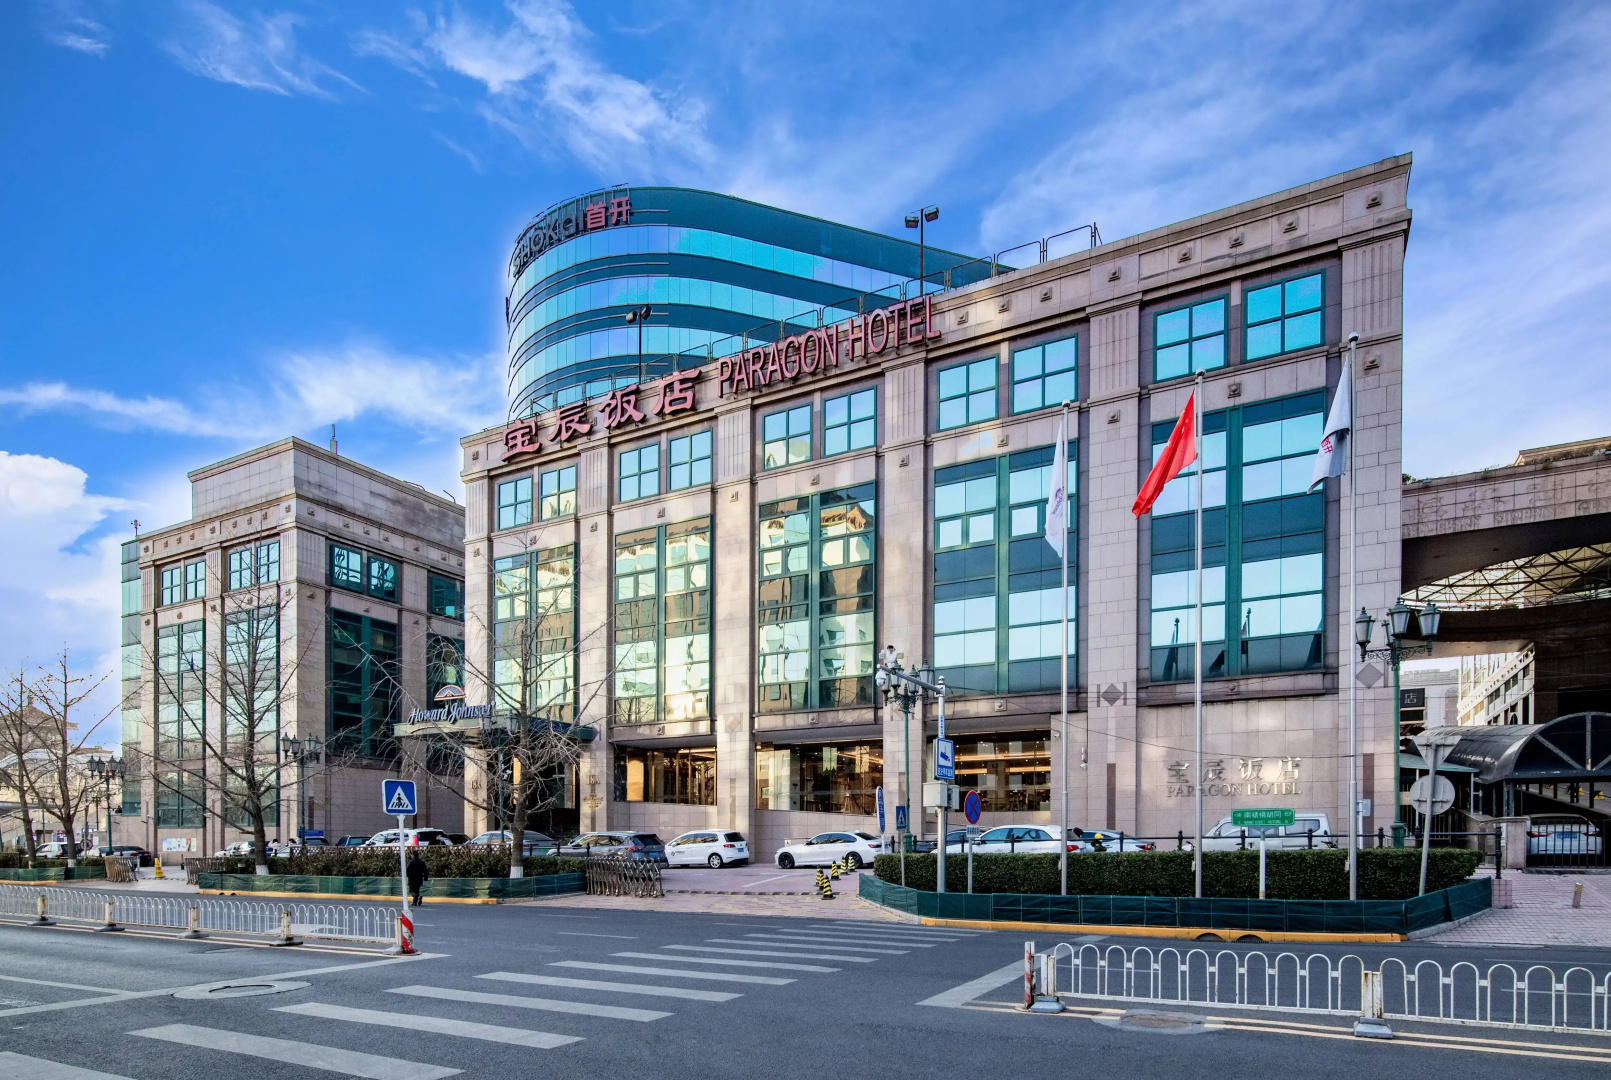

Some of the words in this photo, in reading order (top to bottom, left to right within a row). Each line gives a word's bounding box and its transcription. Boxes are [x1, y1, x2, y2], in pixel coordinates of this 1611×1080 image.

[586, 196, 631, 230] 首开
[717, 324, 839, 399] PARAGON
[848, 295, 942, 362] HOTEL
[500, 369, 701, 462] 宝辰饭店
[407, 703, 448, 725] Howard
[1167, 756, 1301, 783] 宝辰饭店
[1247, 782, 1301, 795] HOTEL
